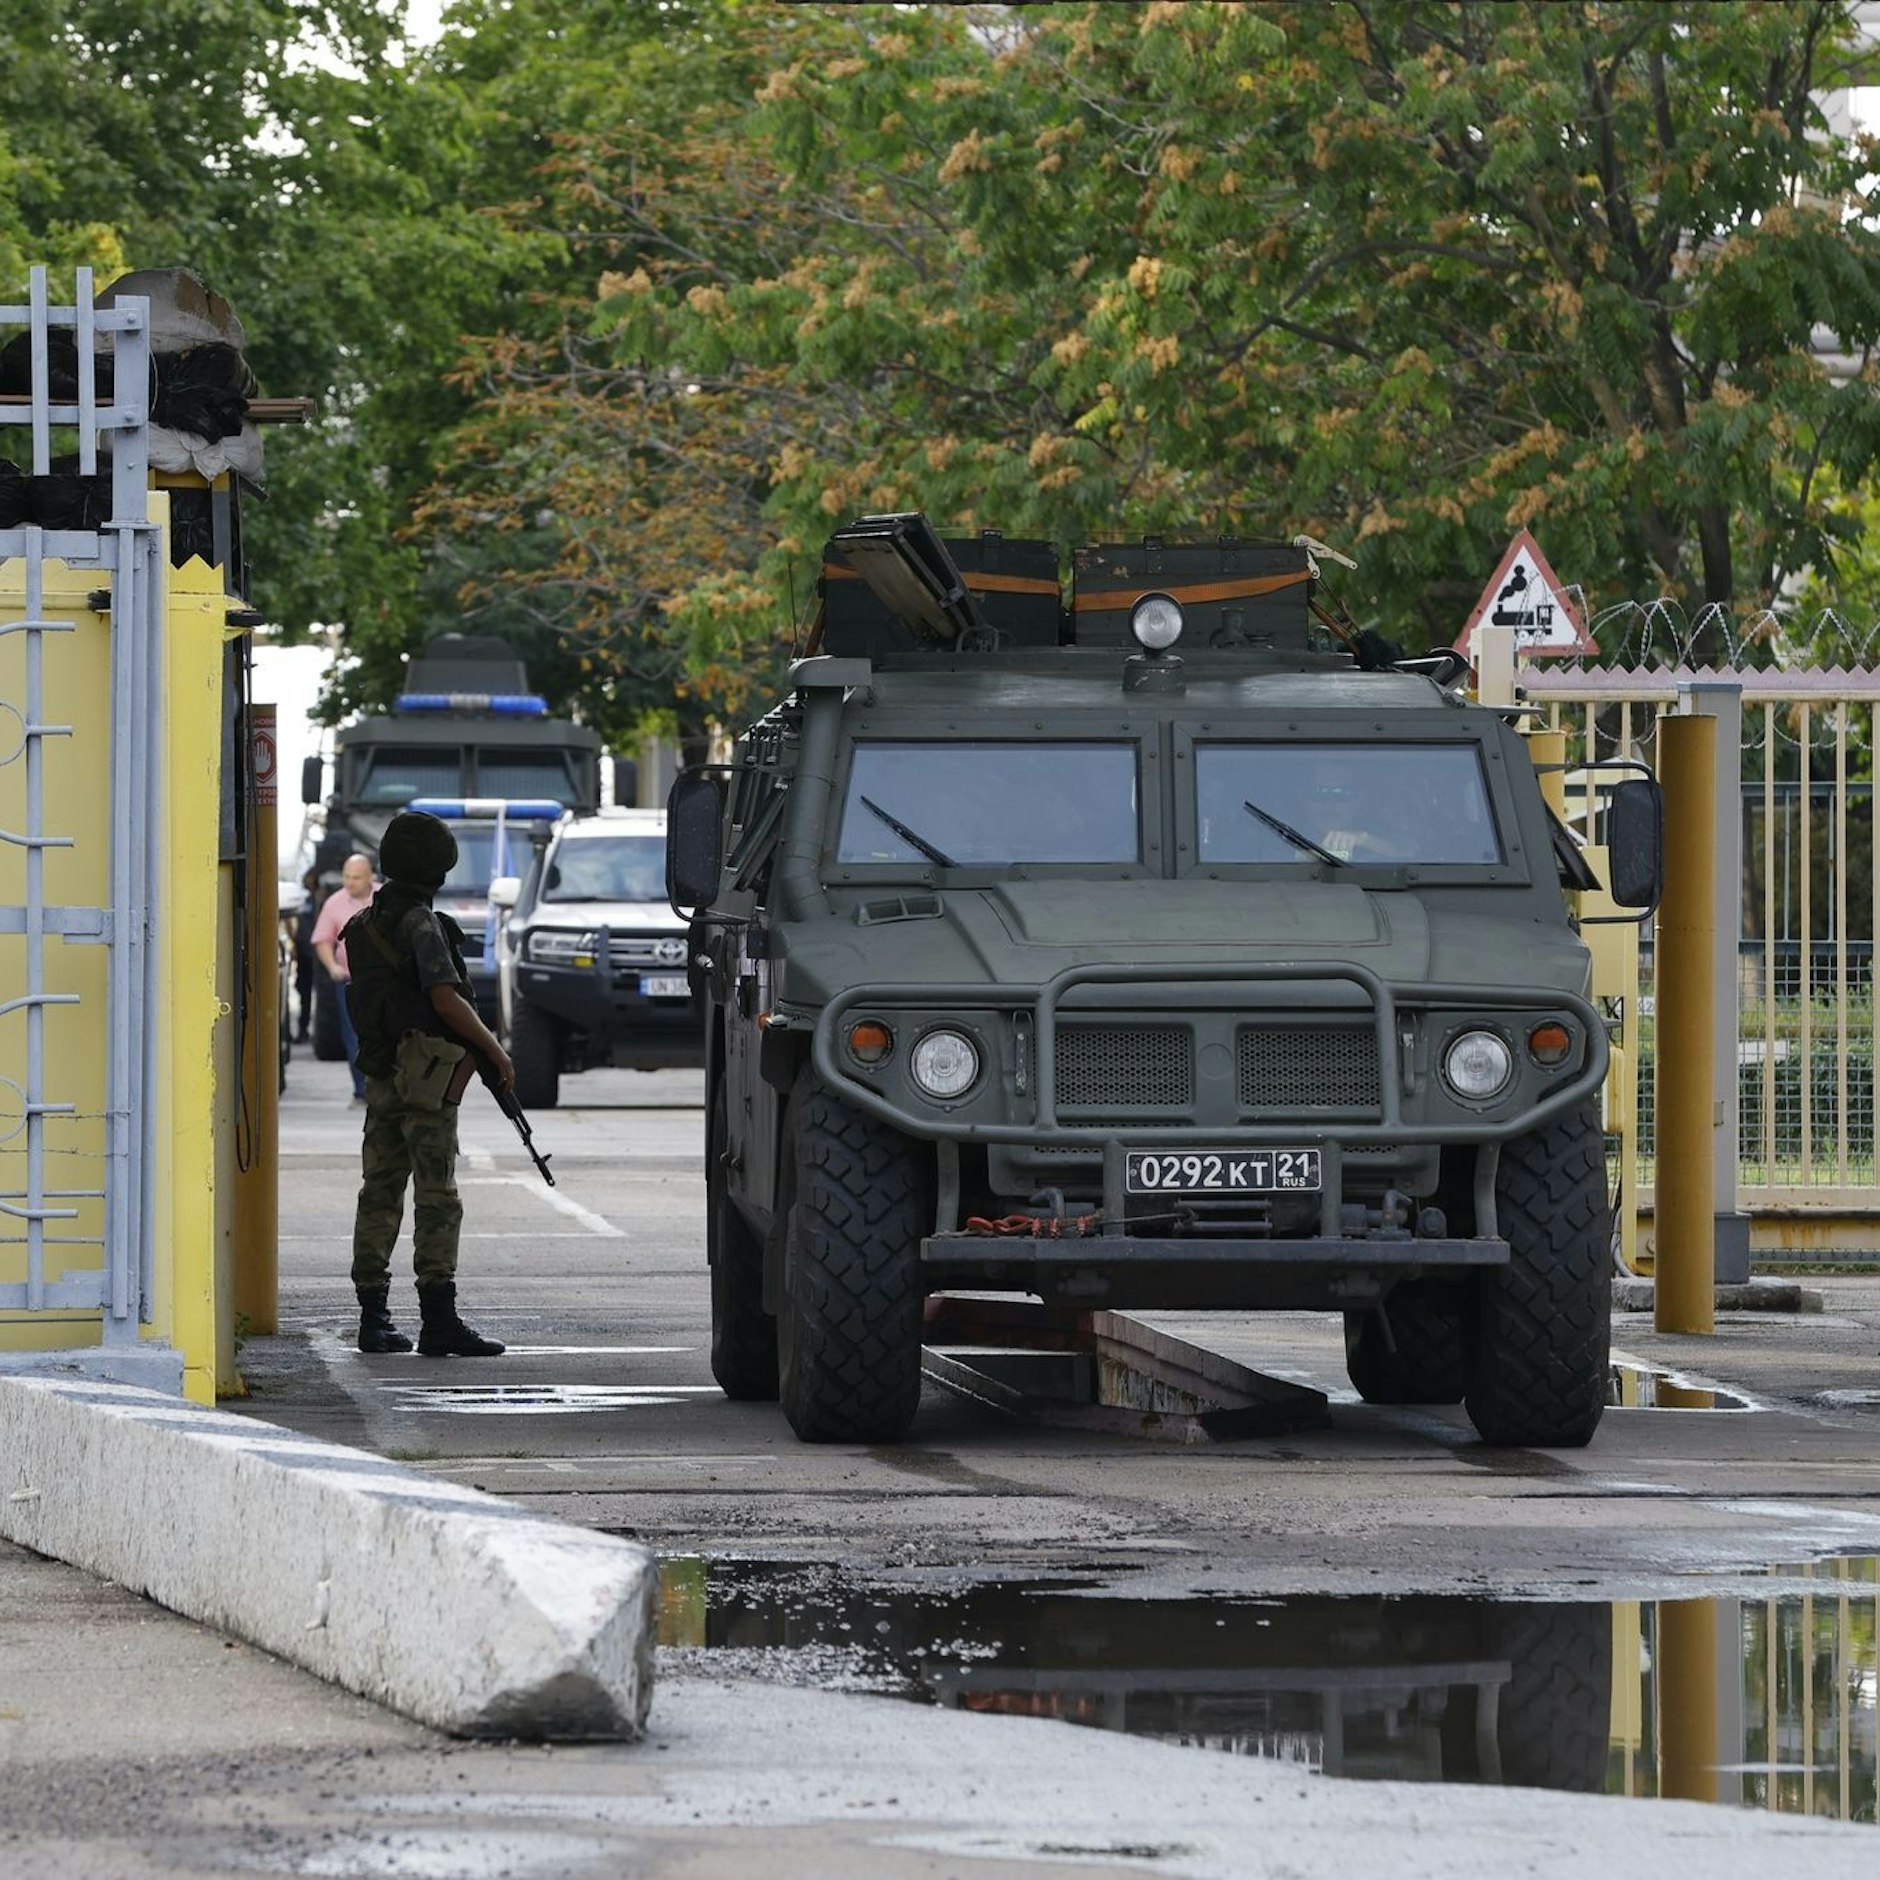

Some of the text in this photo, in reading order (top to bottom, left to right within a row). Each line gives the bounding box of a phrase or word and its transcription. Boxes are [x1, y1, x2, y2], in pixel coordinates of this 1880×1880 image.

[1140, 1155, 1223, 1188] 0292
[1278, 1153, 1310, 1178] 21
[1282, 1177, 1306, 1187] RUS
